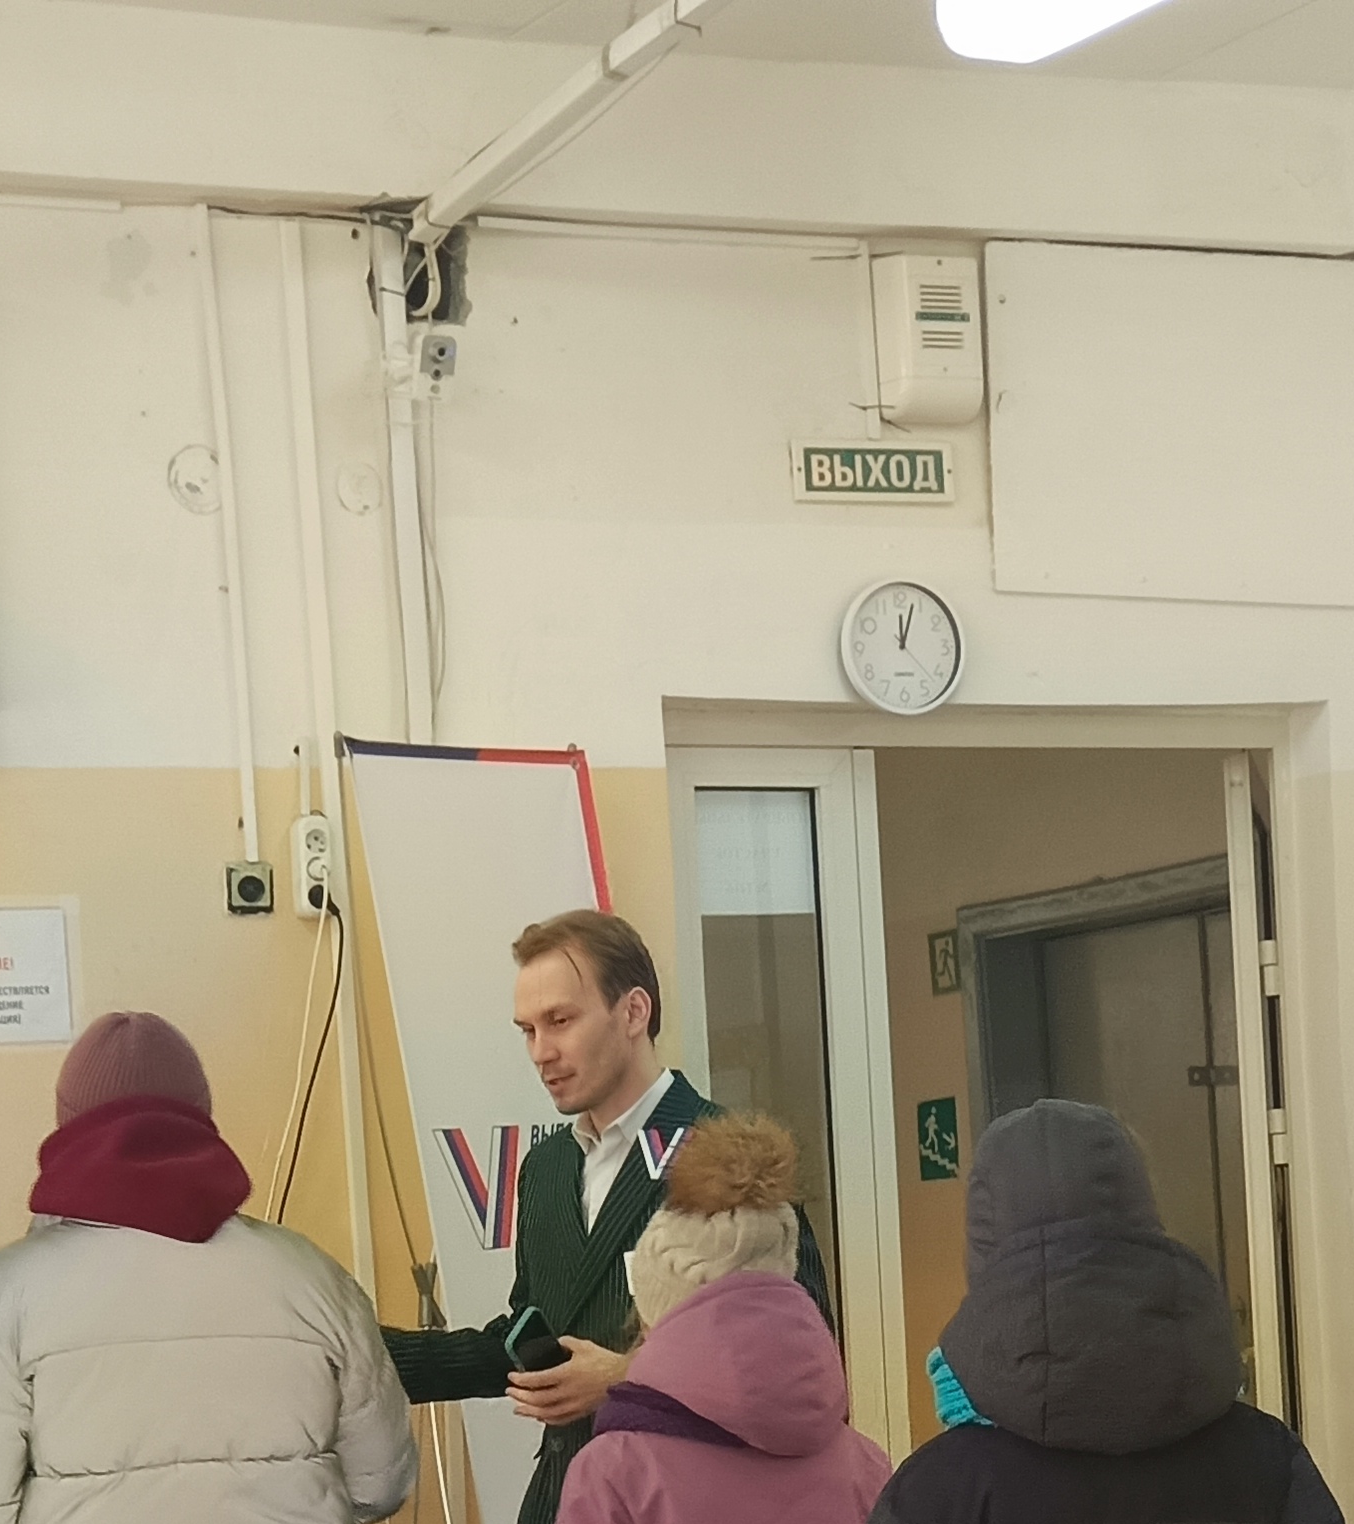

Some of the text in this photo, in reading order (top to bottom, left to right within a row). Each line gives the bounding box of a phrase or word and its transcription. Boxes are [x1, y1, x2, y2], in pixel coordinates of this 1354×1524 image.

[810, 454, 938, 491] ВЫХОД
[875, 598, 887, 615] 11
[893, 591, 906, 609] 12
[860, 616, 877, 635] 10
[931, 614, 941, 632] 2
[854, 641, 865, 658] 9
[941, 638, 950, 656] 3
[864, 663, 875, 681] 8
[933, 663, 944, 678] 4
[880, 680, 891, 696] 7
[900, 686, 911, 703] 6
[920, 680, 930, 697] 5
